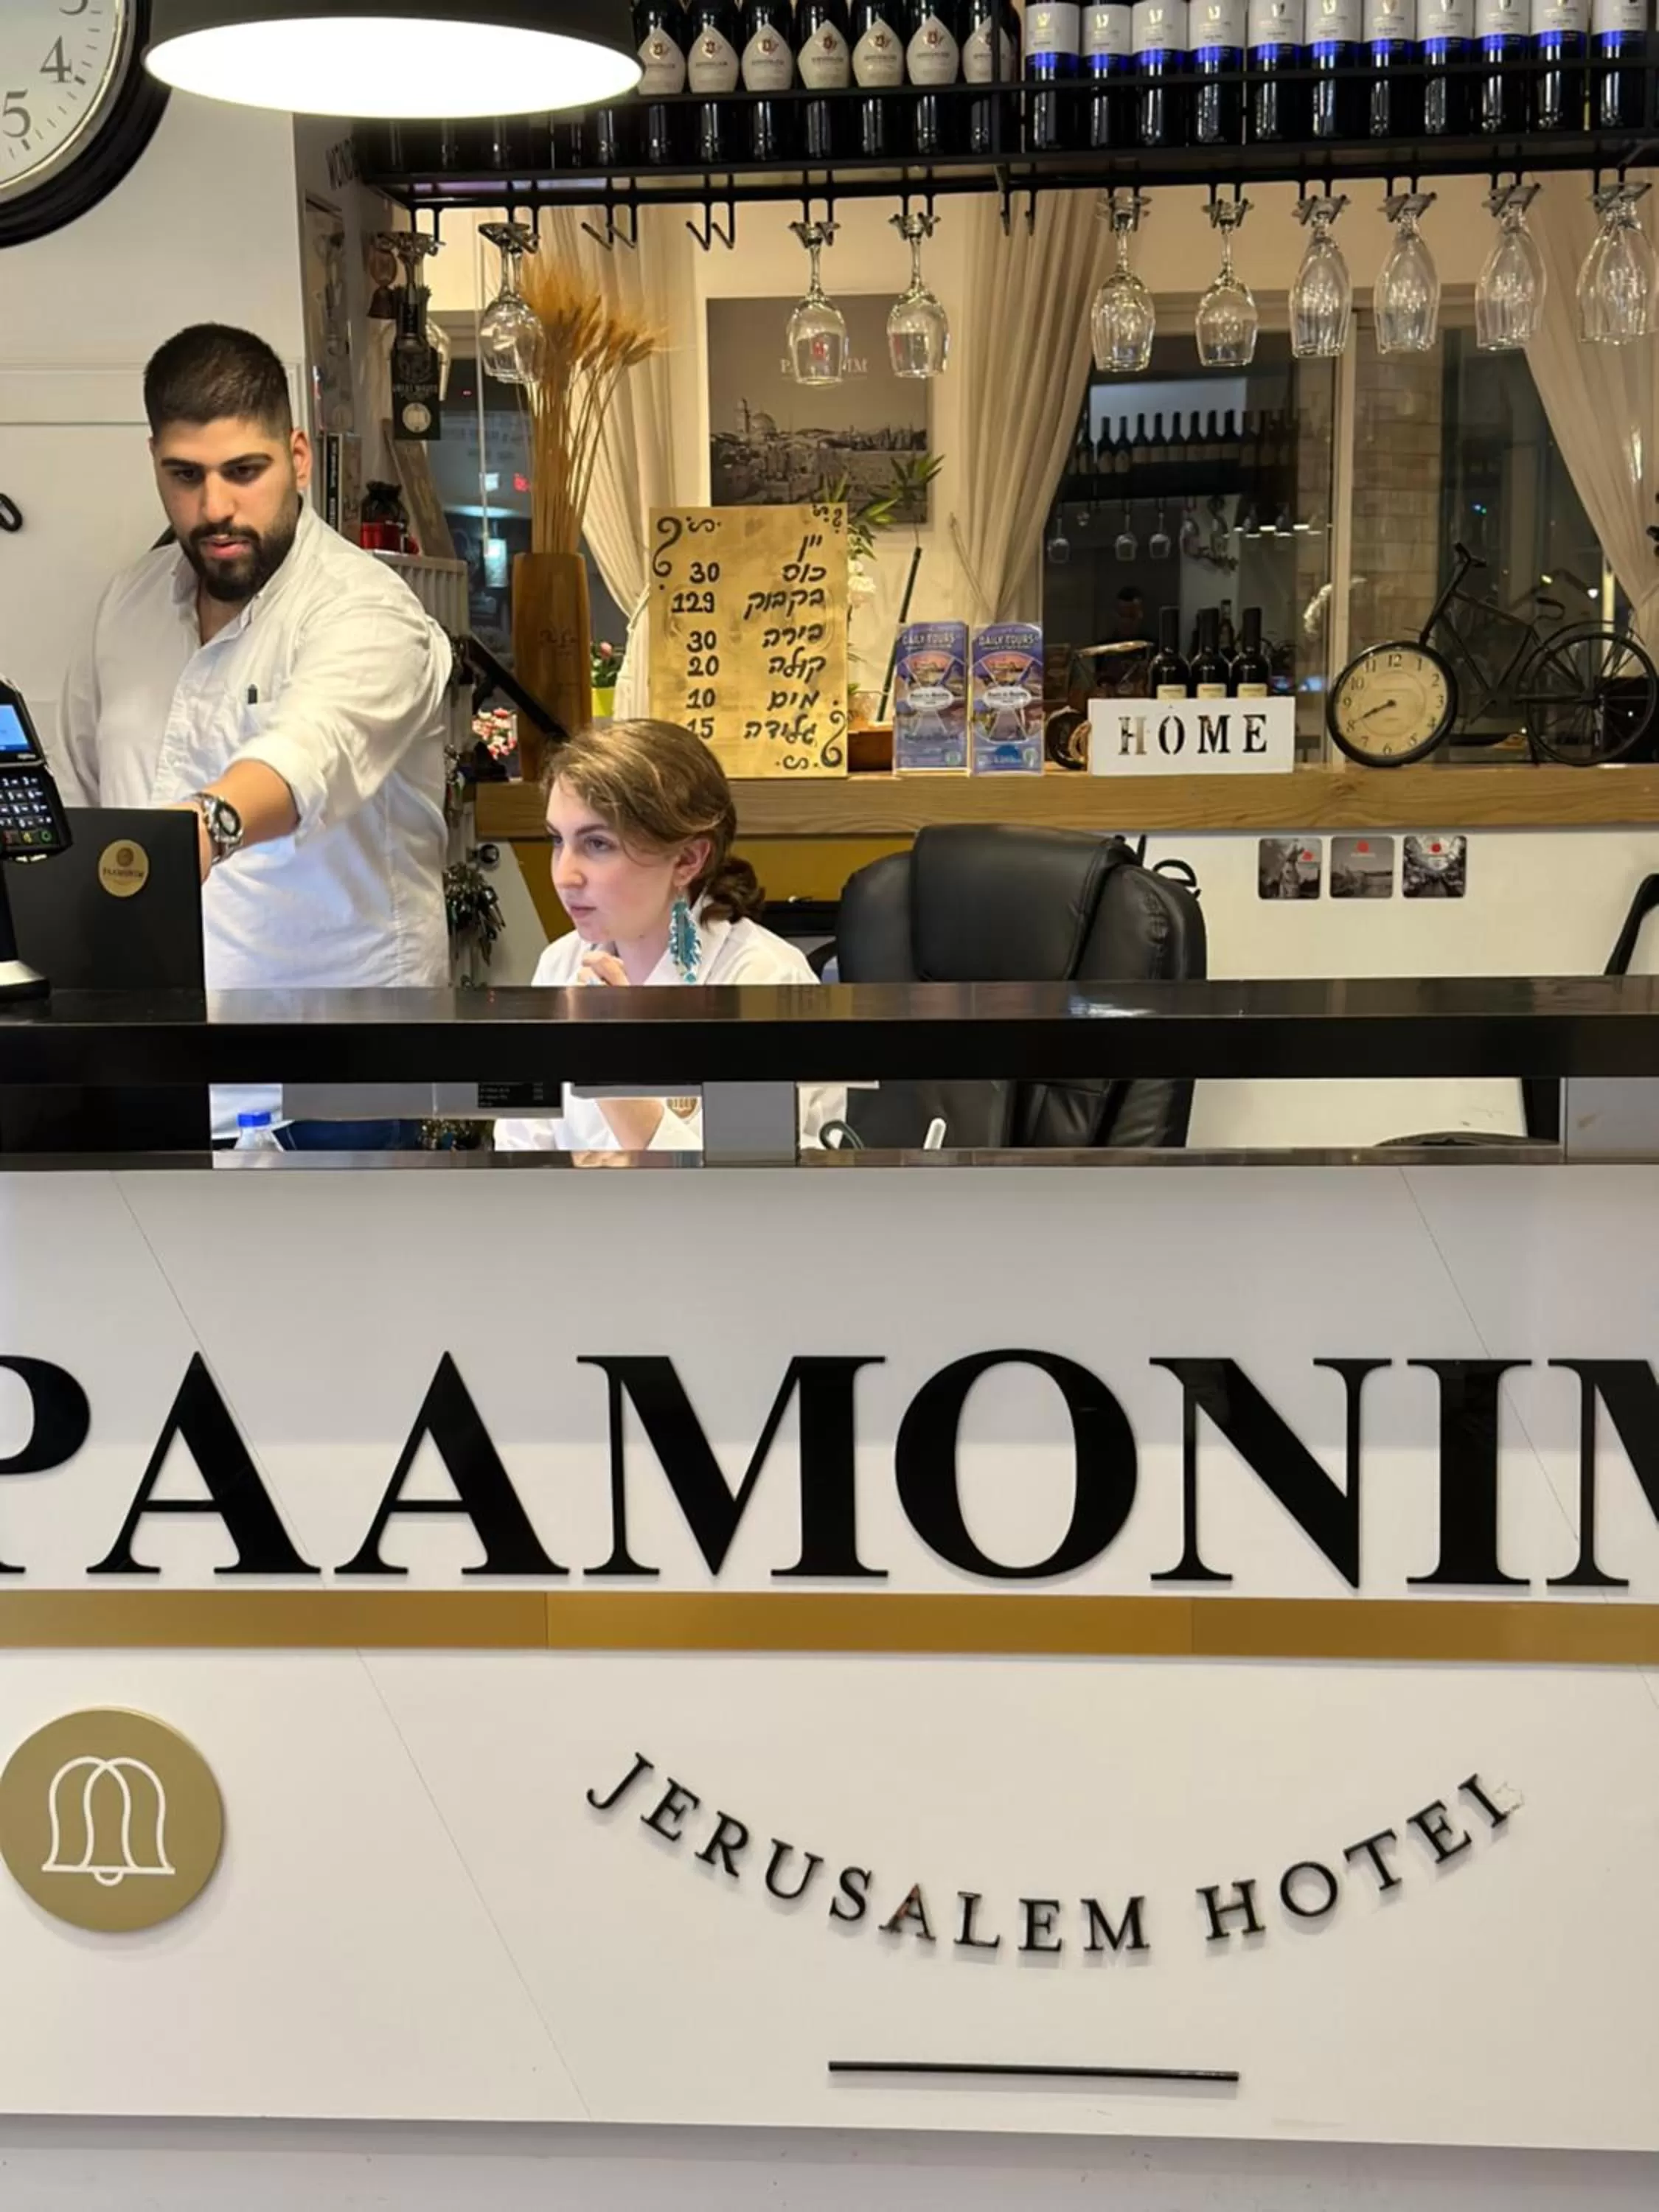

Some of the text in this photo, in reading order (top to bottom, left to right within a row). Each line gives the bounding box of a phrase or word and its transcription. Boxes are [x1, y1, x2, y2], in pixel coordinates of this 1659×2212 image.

[39, 35, 72, 83] 4
[2, 88, 31, 139] 5
[796, 533, 823, 563] יין
[689, 561, 827, 585] כוס 30
[671, 588, 825, 621] בקבוק 129
[686, 623, 824, 653] בירה 30
[687, 646, 827, 684] קולה 20
[1388, 654, 1402, 667] 12
[686, 687, 820, 712] מים 10
[688, 712, 818, 745] גלידה 15
[1118, 714, 1267, 755] HOME
[586, 1753, 1150, 1952] JERUSALEM
